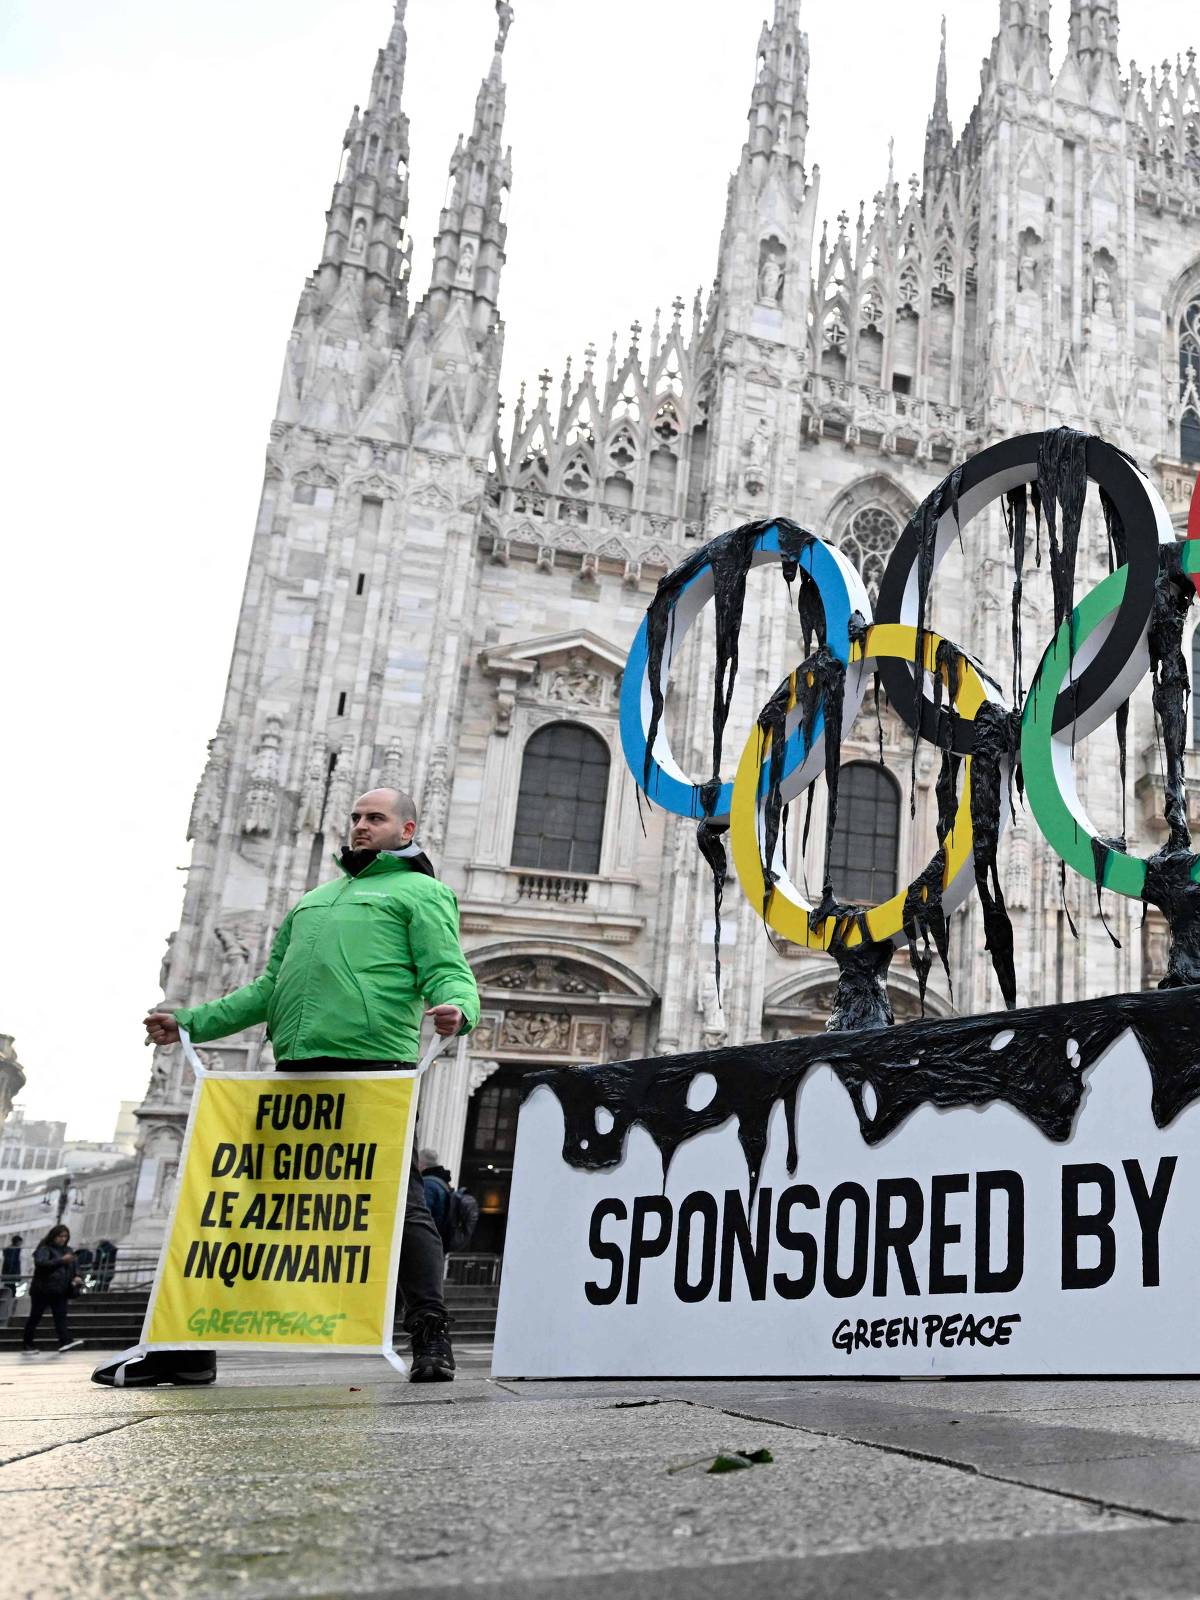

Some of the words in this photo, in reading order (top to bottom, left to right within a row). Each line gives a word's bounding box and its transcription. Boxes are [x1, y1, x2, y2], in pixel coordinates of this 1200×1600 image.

[256, 1093, 345, 1130] FUORI
[211, 1143, 264, 1180] DAI
[273, 1143, 377, 1181] GIOCHI
[200, 1191, 240, 1228] LE
[240, 1193, 369, 1231] AZIENDE
[584, 1169, 1025, 1306] SPONSORED
[1061, 1156, 1178, 1290] BY
[183, 1241, 371, 1288] INQUINANTI
[187, 1307, 346, 1337] GREENPEACE
[831, 1313, 1022, 1355] GREENPEACE
